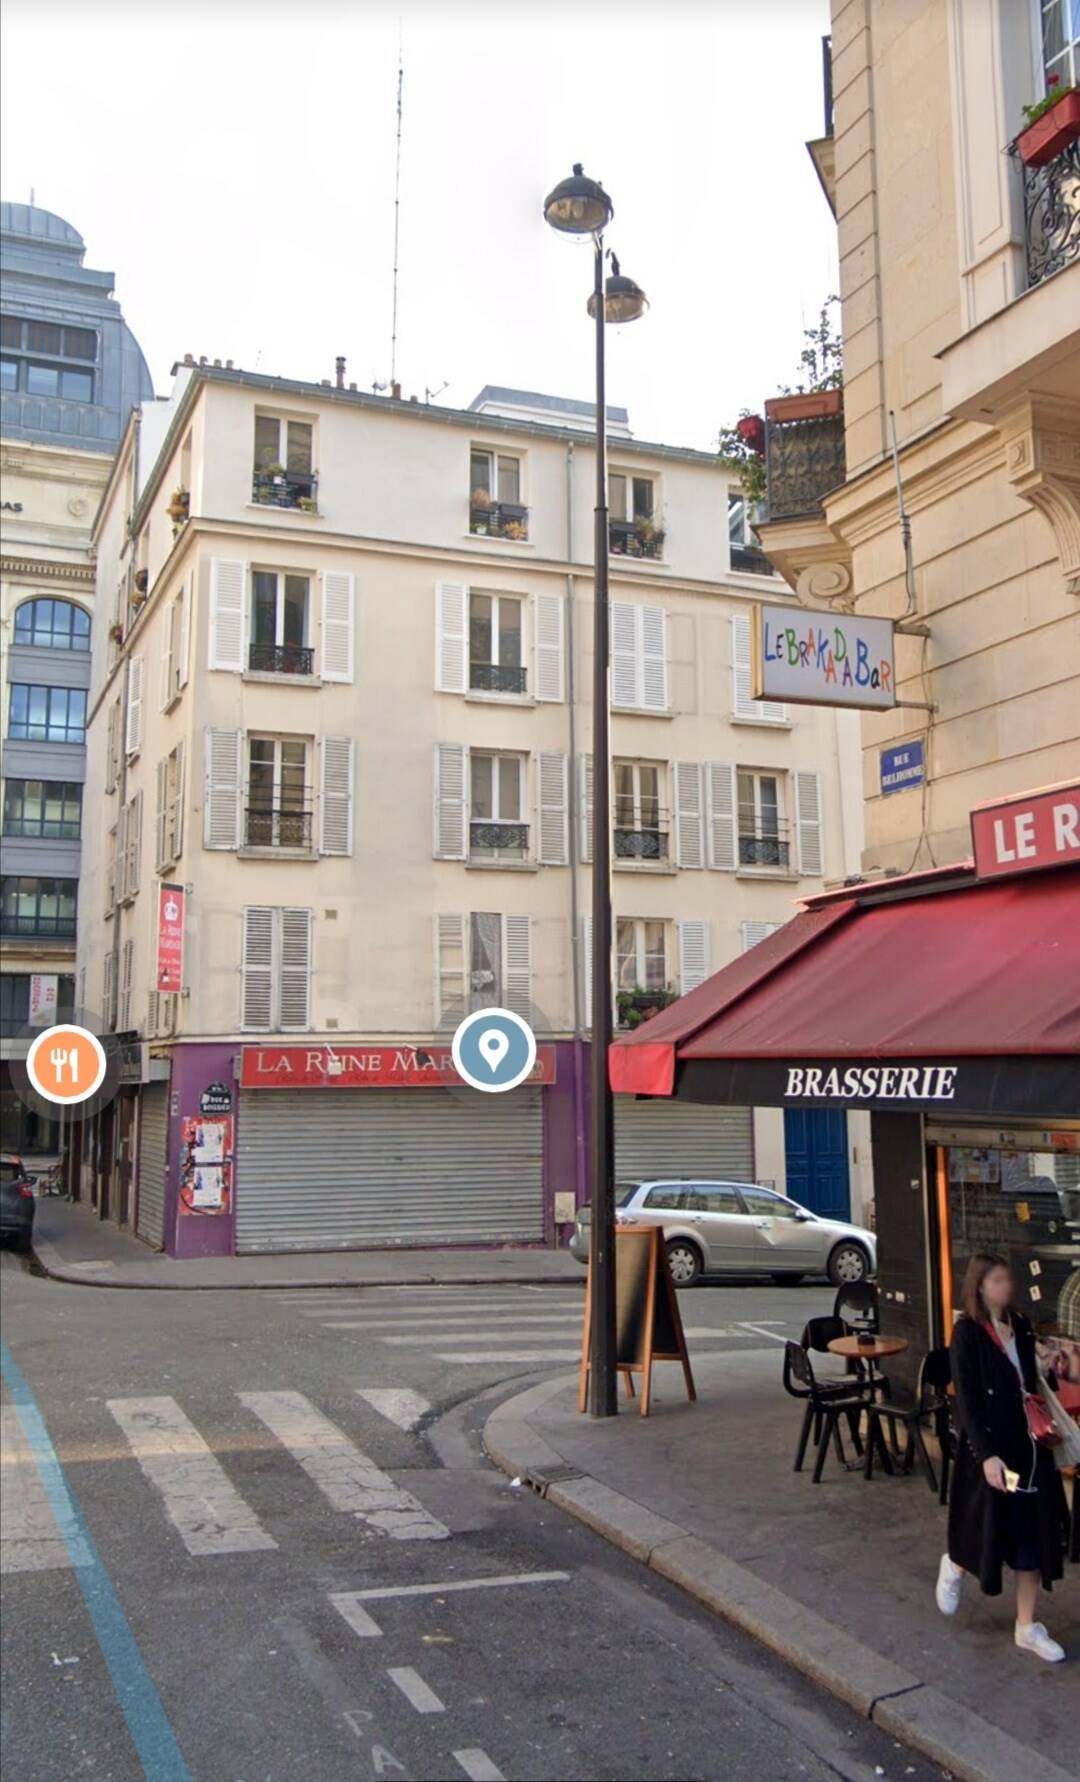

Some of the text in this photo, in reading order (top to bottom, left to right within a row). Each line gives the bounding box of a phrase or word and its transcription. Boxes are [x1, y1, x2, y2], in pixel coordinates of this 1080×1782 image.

[0, 501, 23, 512] AS
[993, 803, 1080, 864] LE R
[256, 1052, 293, 1072] LA
[390, 1051, 456, 1072] MAR
[784, 1066, 958, 1099] BRASSERIE
